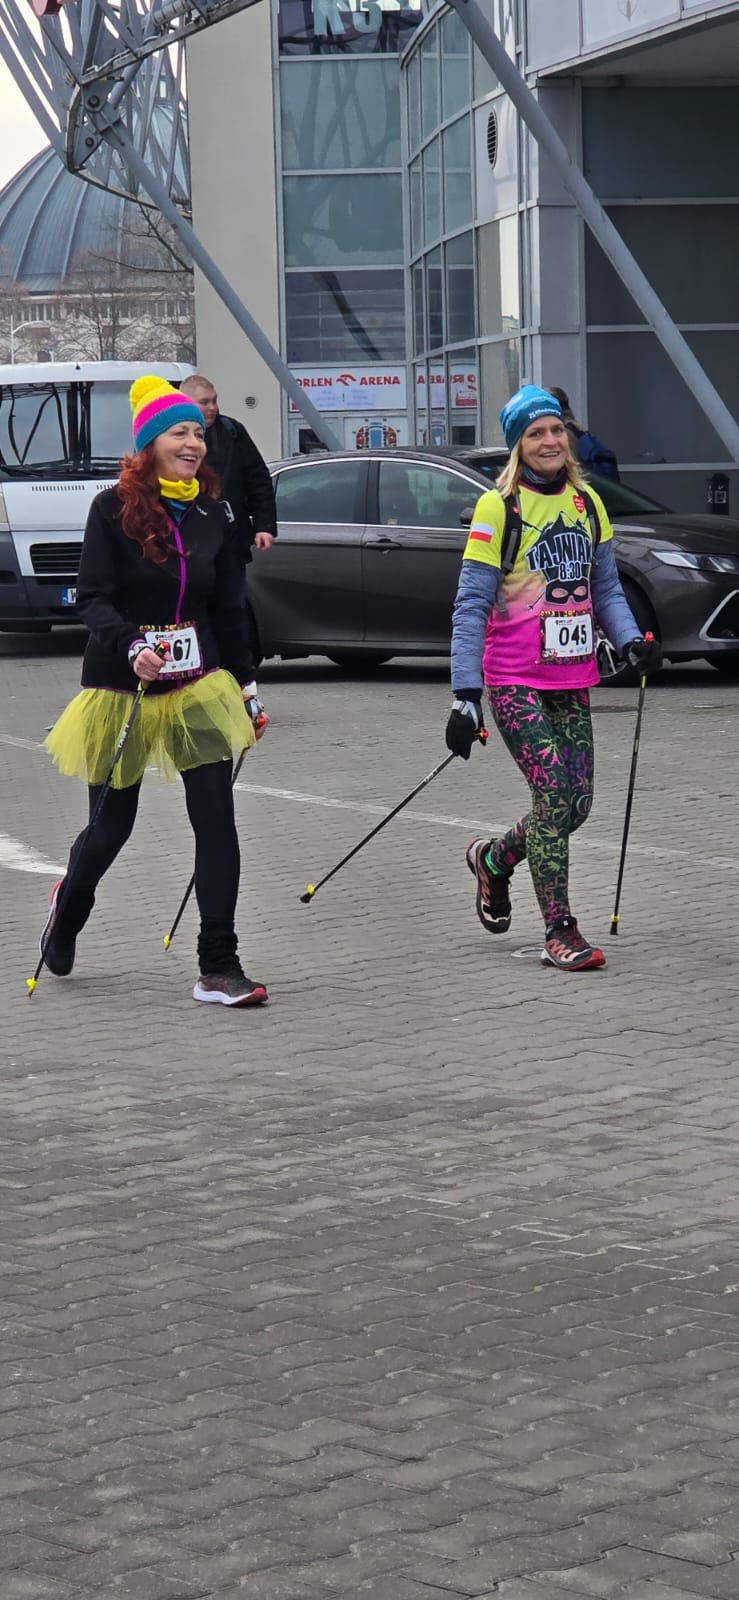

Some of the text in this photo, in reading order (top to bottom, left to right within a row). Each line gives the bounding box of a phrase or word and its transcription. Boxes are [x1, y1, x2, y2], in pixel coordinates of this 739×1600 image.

[359, 376, 400, 386] ARENA
[559, 561, 581, 581] 8:30
[559, 624, 587, 646] 045
[168, 637, 192, 661] 67
